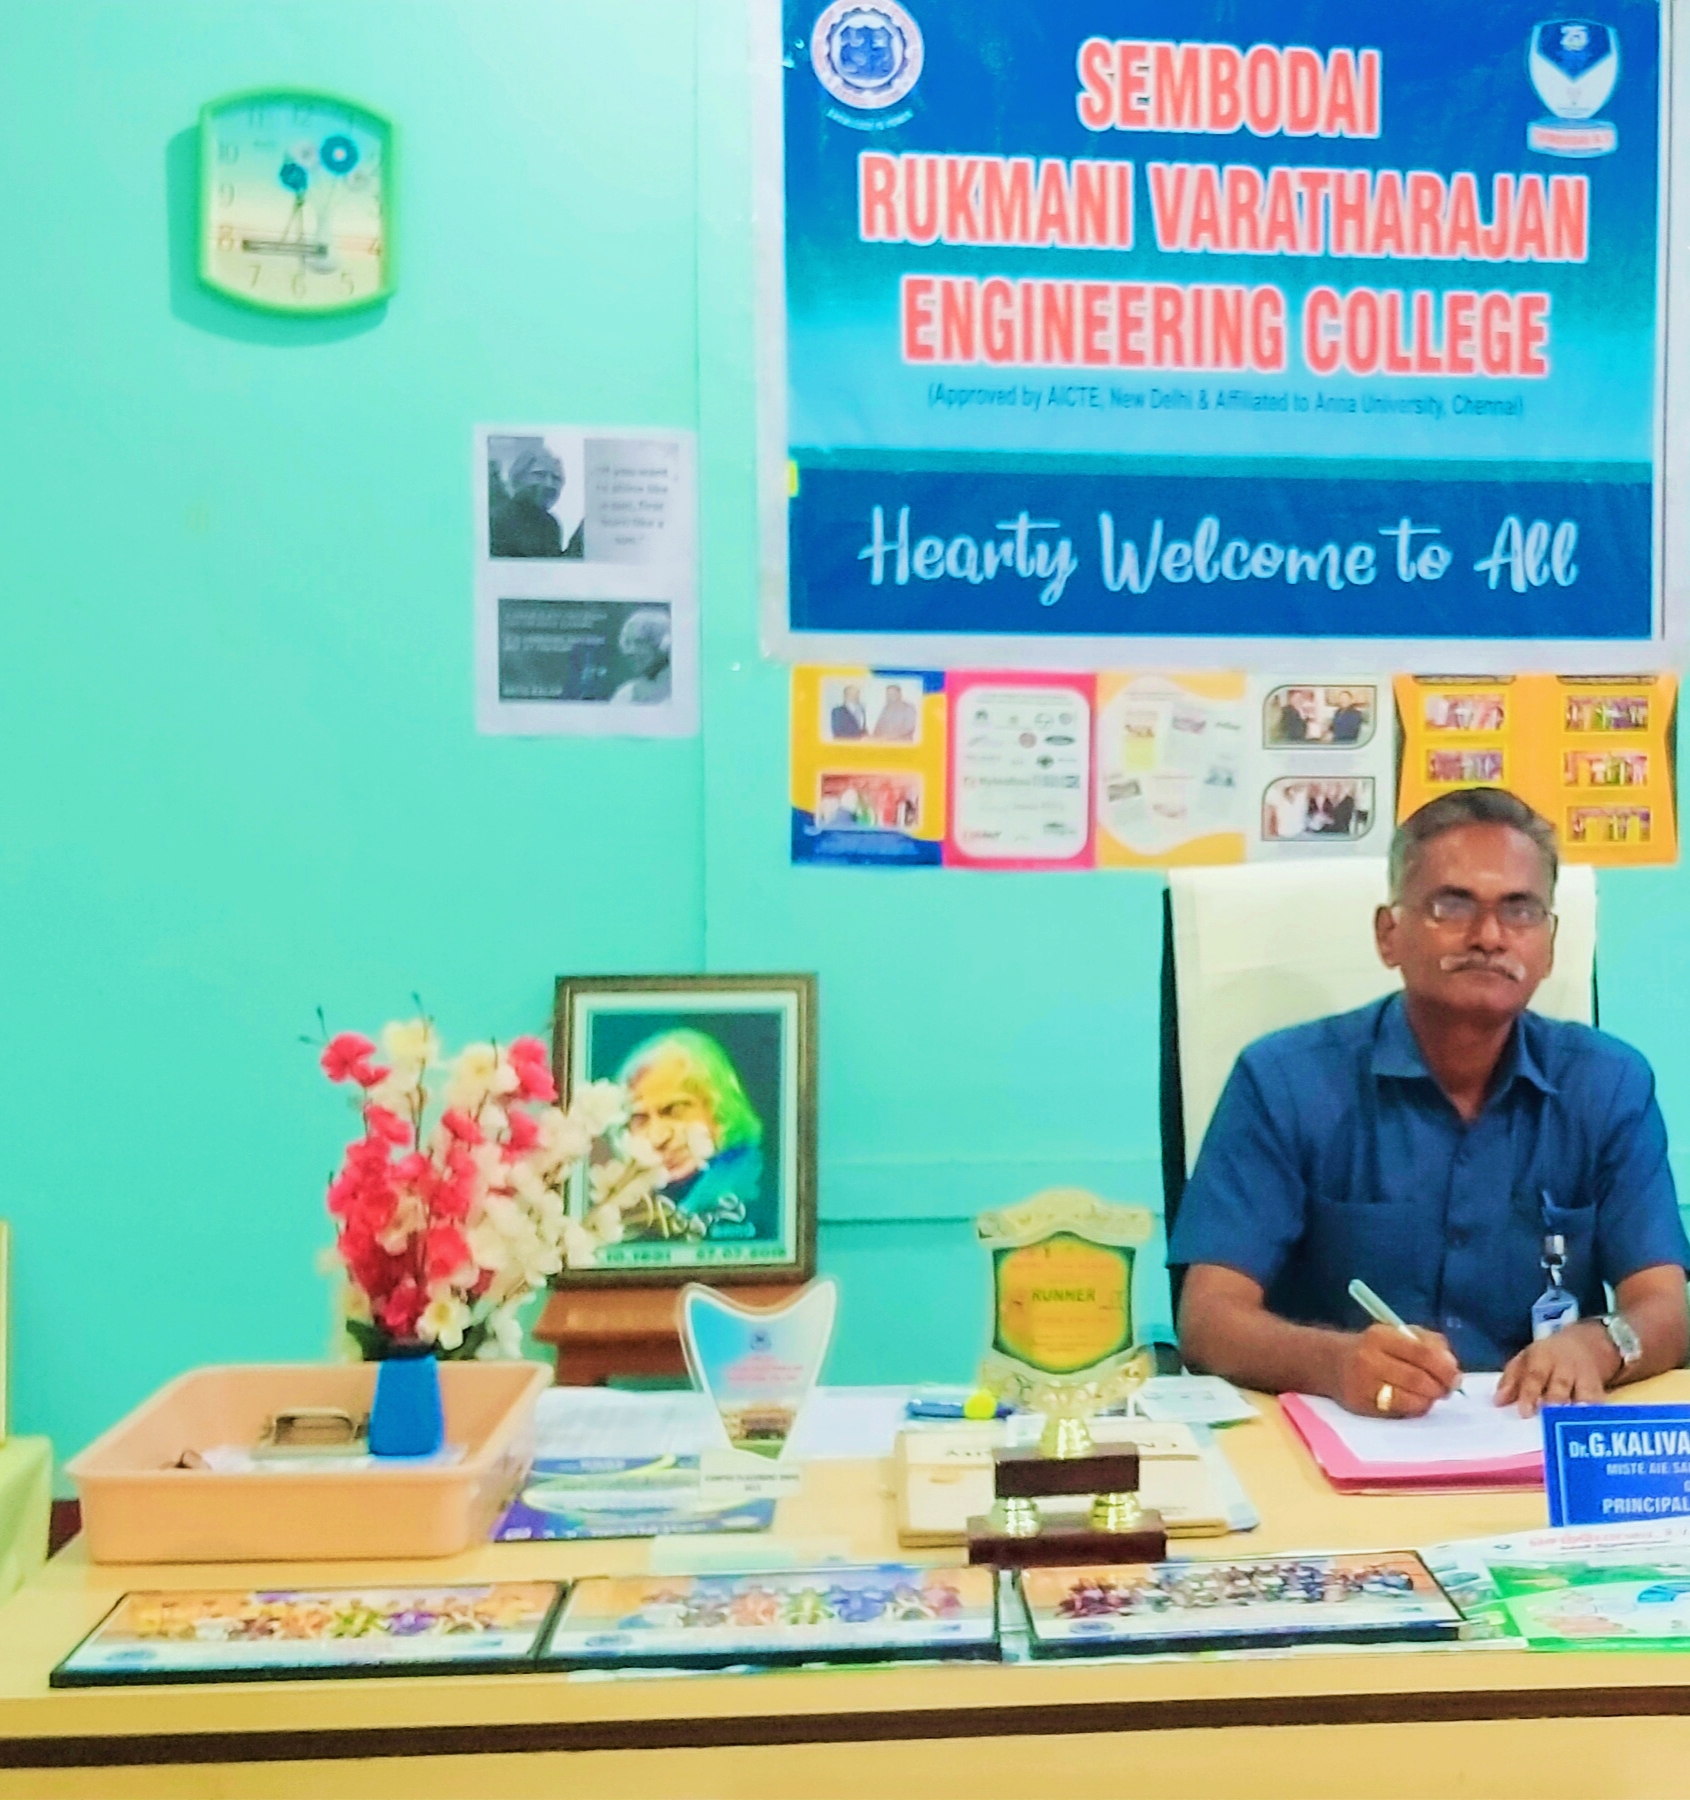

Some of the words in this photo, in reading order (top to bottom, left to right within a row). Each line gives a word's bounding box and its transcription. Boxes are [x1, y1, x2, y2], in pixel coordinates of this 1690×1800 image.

[1081, 41, 1378, 135] SEMBODAI
[862, 155, 1131, 246] RUKMANI
[1151, 165, 1587, 259] VARATHARAJAN
[903, 277, 1285, 371] ENGINEERING
[1305, 288, 1547, 376] COLLEGE
[928, 383, 1016, 410] (Approved
[1022, 385, 1042, 412] by
[1111, 387, 1144, 409] New
[1150, 388, 1193, 410] Delhi
[1199, 389, 1208, 410] &
[1294, 391, 1309, 412] to
[1316, 391, 1357, 413] Anna
[860, 507, 1077, 604] Hearty
[1101, 513, 1376, 594] Welcome
[1379, 516, 1452, 584] to
[1474, 515, 1578, 594] All
[1031, 1288, 1096, 1302] RUNNER
